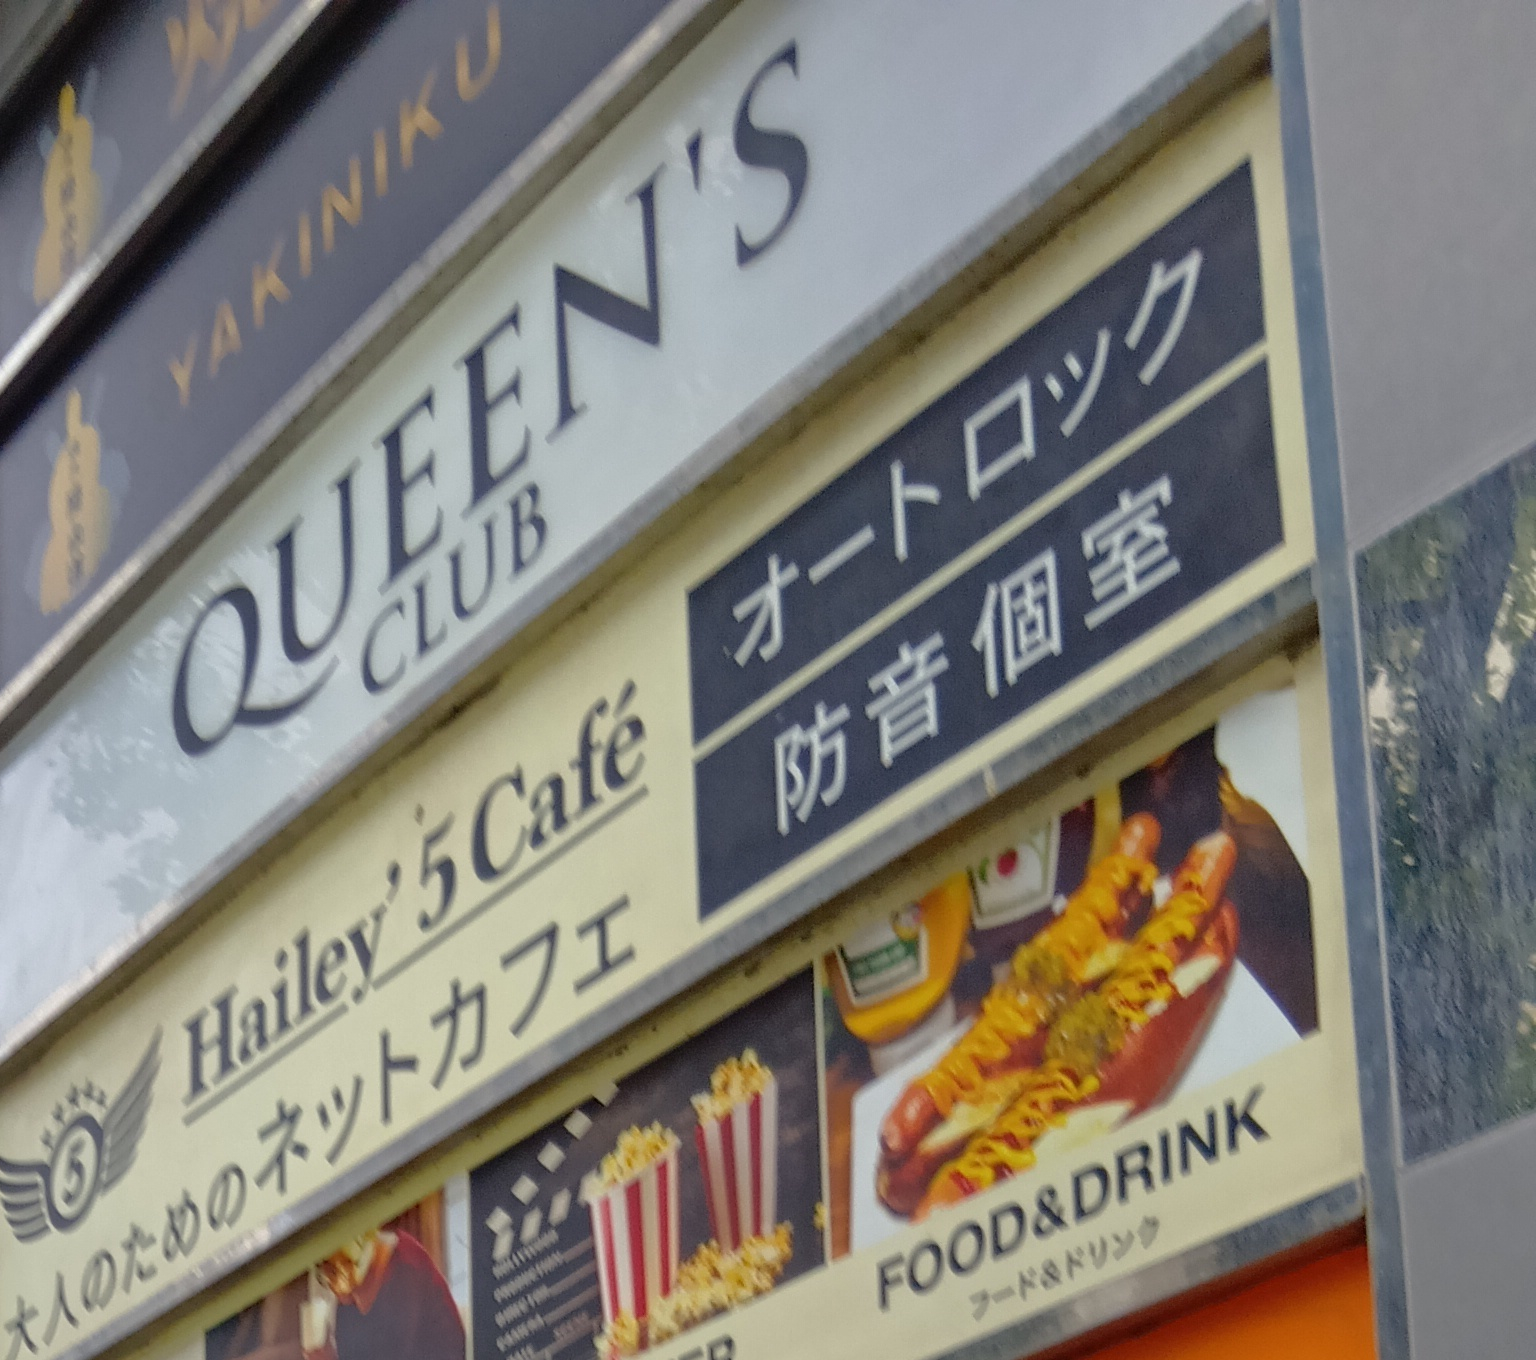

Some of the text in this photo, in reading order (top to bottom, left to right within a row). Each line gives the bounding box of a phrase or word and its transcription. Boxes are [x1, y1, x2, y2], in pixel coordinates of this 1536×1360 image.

[168, 3, 502, 409] YAKINIKU
[172, 38, 810, 758] QUEEN'S
[731, 249, 1203, 667] オートロック
[361, 481, 549, 697] CLUB
[773, 475, 1181, 836] 防音個室
[472, 678, 647, 882] Café
[876, 1082, 1271, 1313] FOOD&DRINK
